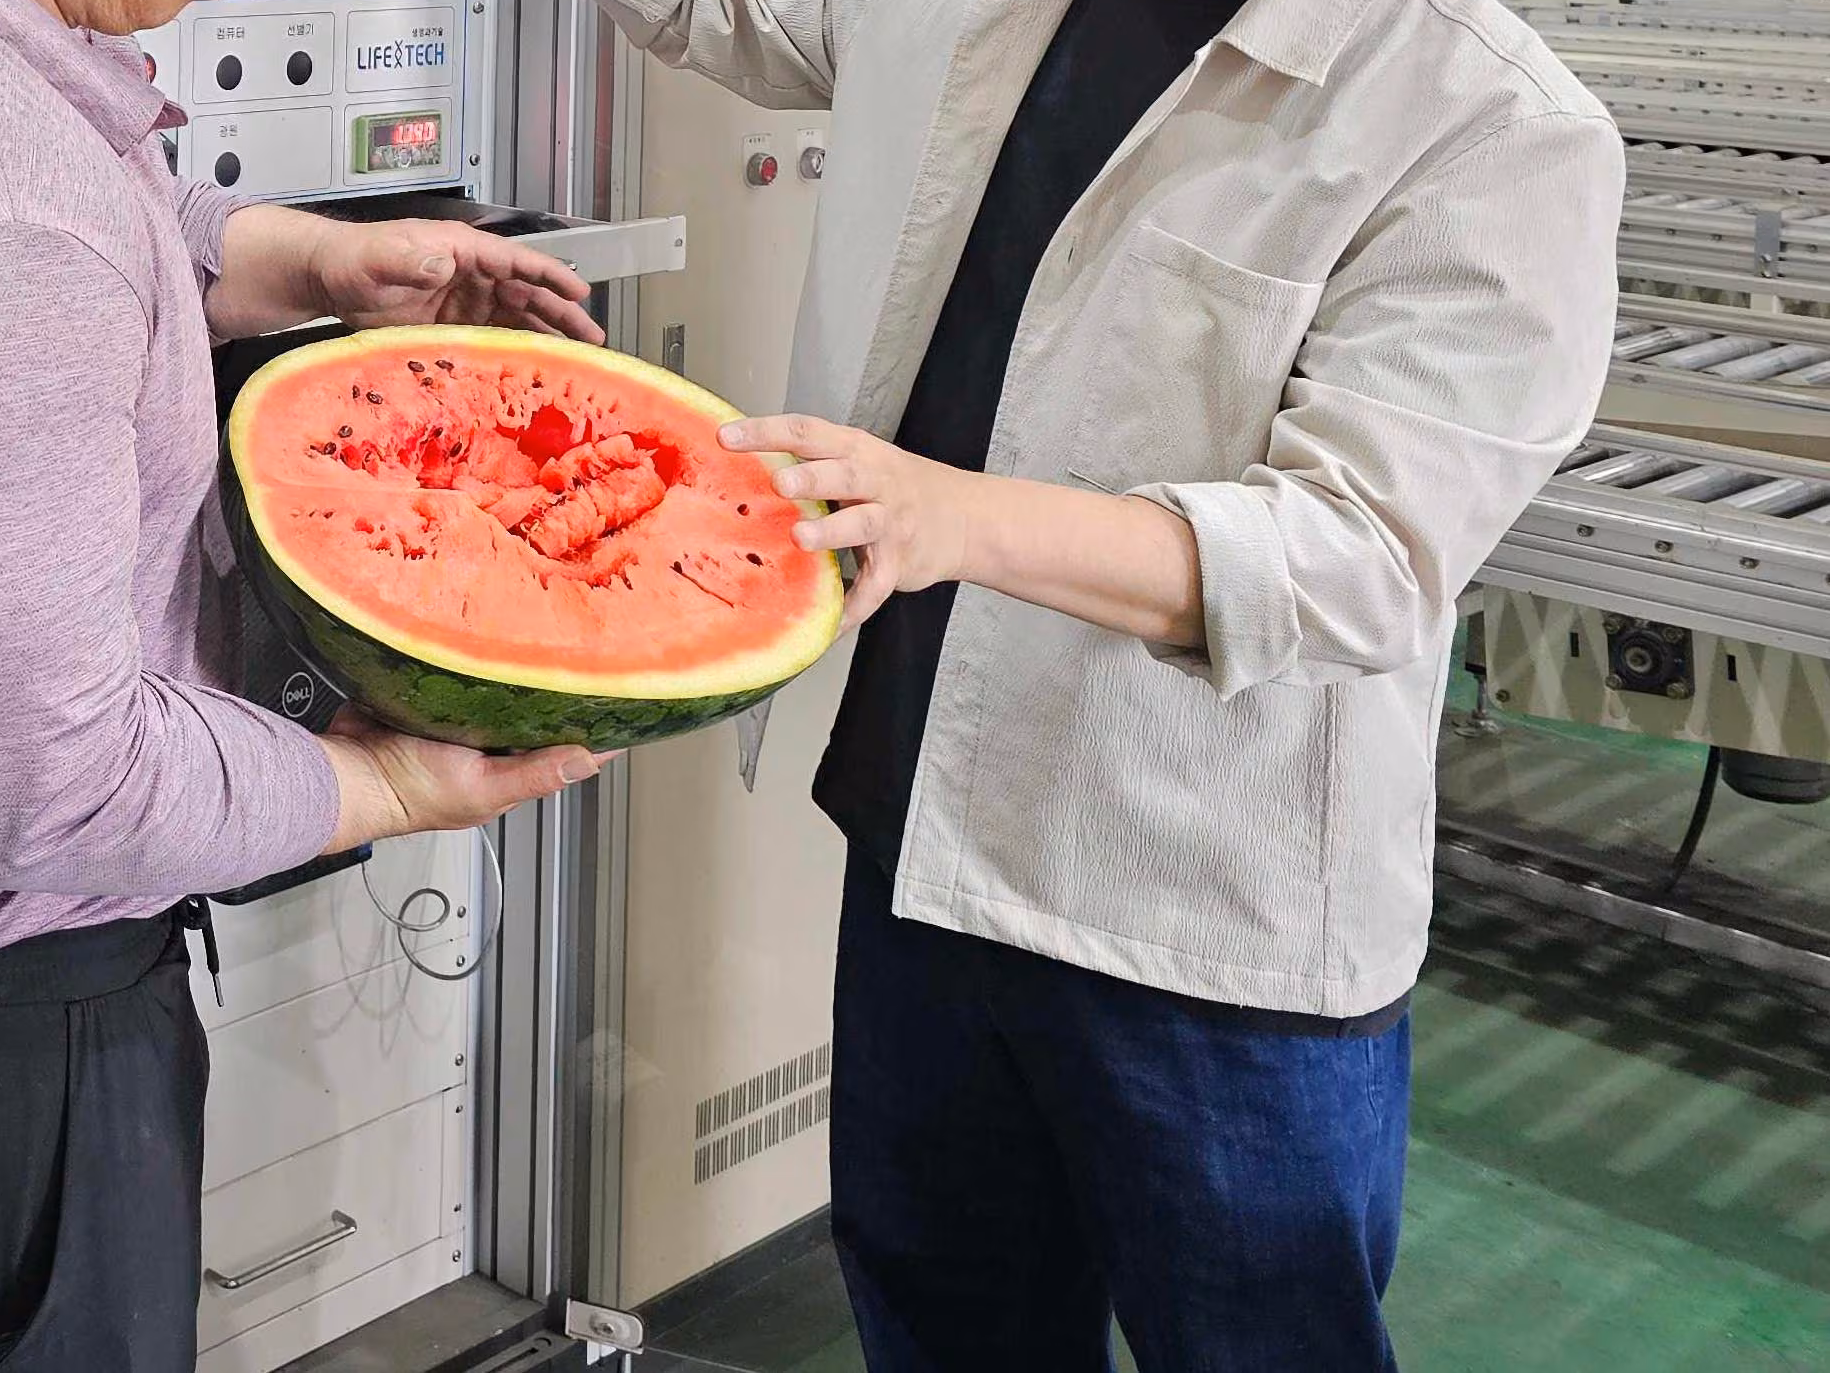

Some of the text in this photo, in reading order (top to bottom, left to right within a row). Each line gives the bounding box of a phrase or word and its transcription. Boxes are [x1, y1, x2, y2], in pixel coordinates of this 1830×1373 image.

[287, 23, 314, 36] 선별기
[357, 42, 445, 70] LIFE TECH
[286, 687, 311, 703] DELL
